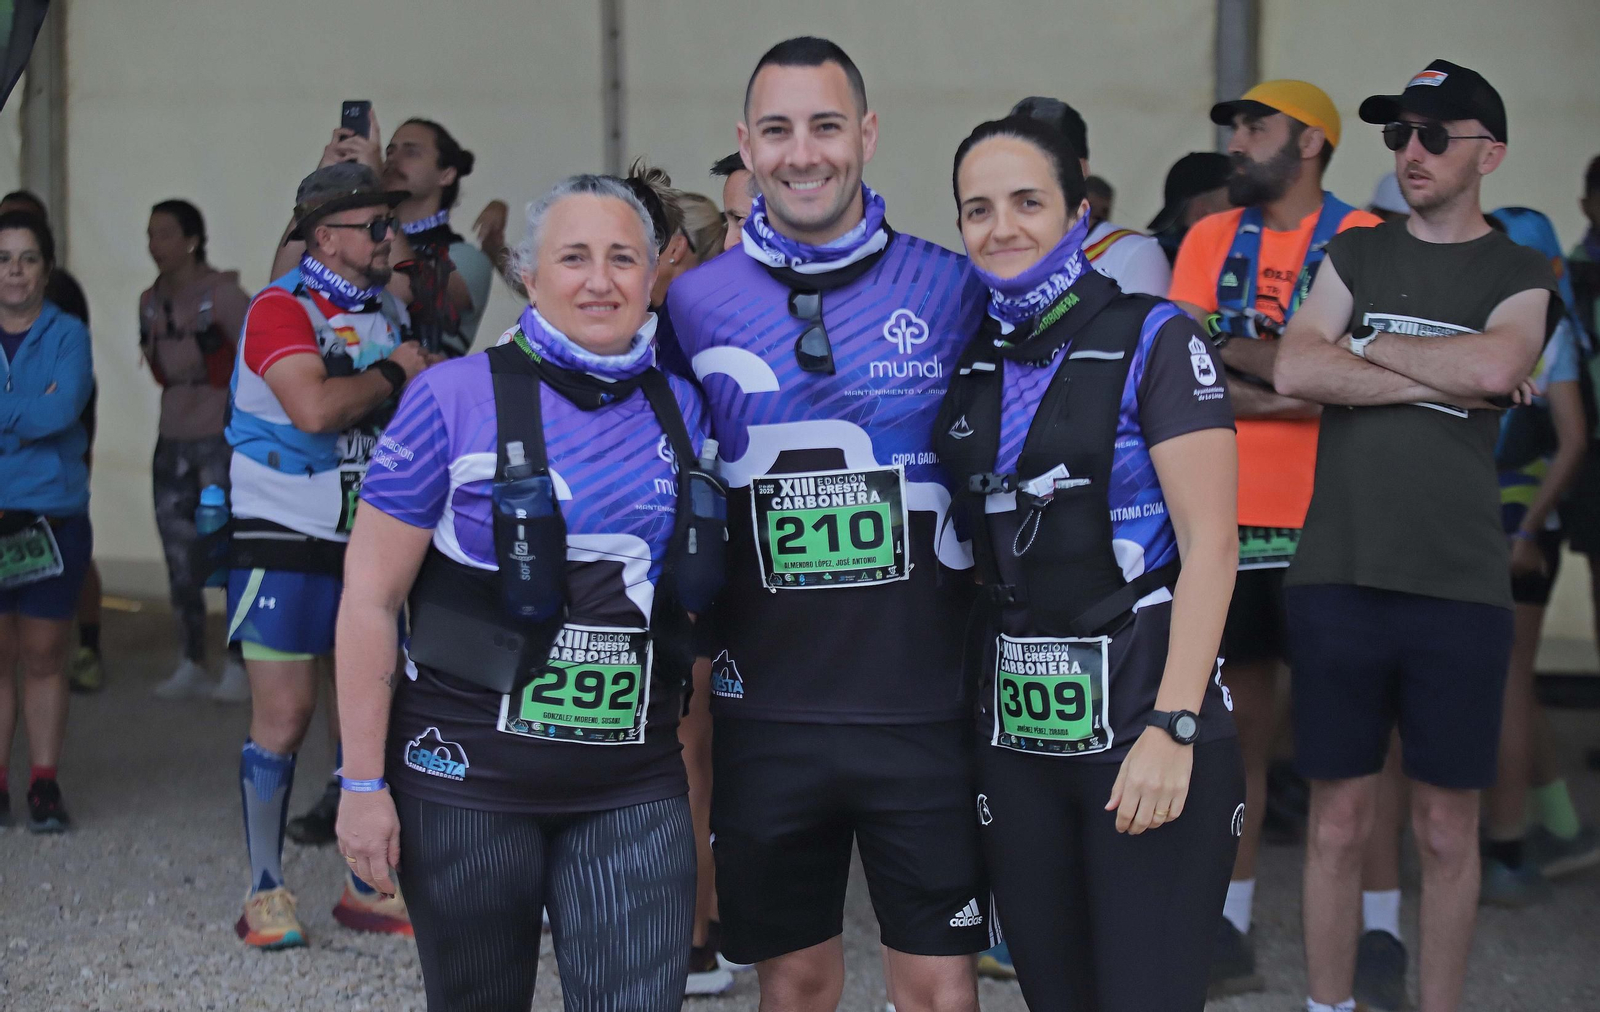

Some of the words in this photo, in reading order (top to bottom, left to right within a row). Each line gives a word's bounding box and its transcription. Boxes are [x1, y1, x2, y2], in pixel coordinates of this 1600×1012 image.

[1388, 320, 1420, 336] XIII
[870, 355, 943, 378] mundi
[844, 388, 915, 397] MANTENIMIENTO
[892, 453, 917, 466] COPA
[779, 478, 816, 498] XIII
[817, 474, 866, 485] EDICIÓN
[817, 482, 868, 495] CRESTA
[771, 490, 881, 510] CARBONERA
[775, 510, 885, 555] 210
[784, 561, 814, 569] ALMENDRO
[836, 557, 850, 567] JOSÉ
[852, 556, 877, 565] ANTONIO
[590, 633, 631, 642] EDICIÓN
[588, 641, 630, 652] CRESTA
[1003, 641, 1023, 662] XIII
[1024, 643, 1069, 653] EDICIÓN
[549, 647, 637, 664] ARBONERA
[1024, 652, 1070, 663] CRESTA
[1001, 658, 1081, 675] CARBONERA
[531, 666, 636, 710] 292
[1002, 678, 1086, 722] 309
[409, 748, 466, 778] CRESTA
[950, 915, 983, 927] adidas
